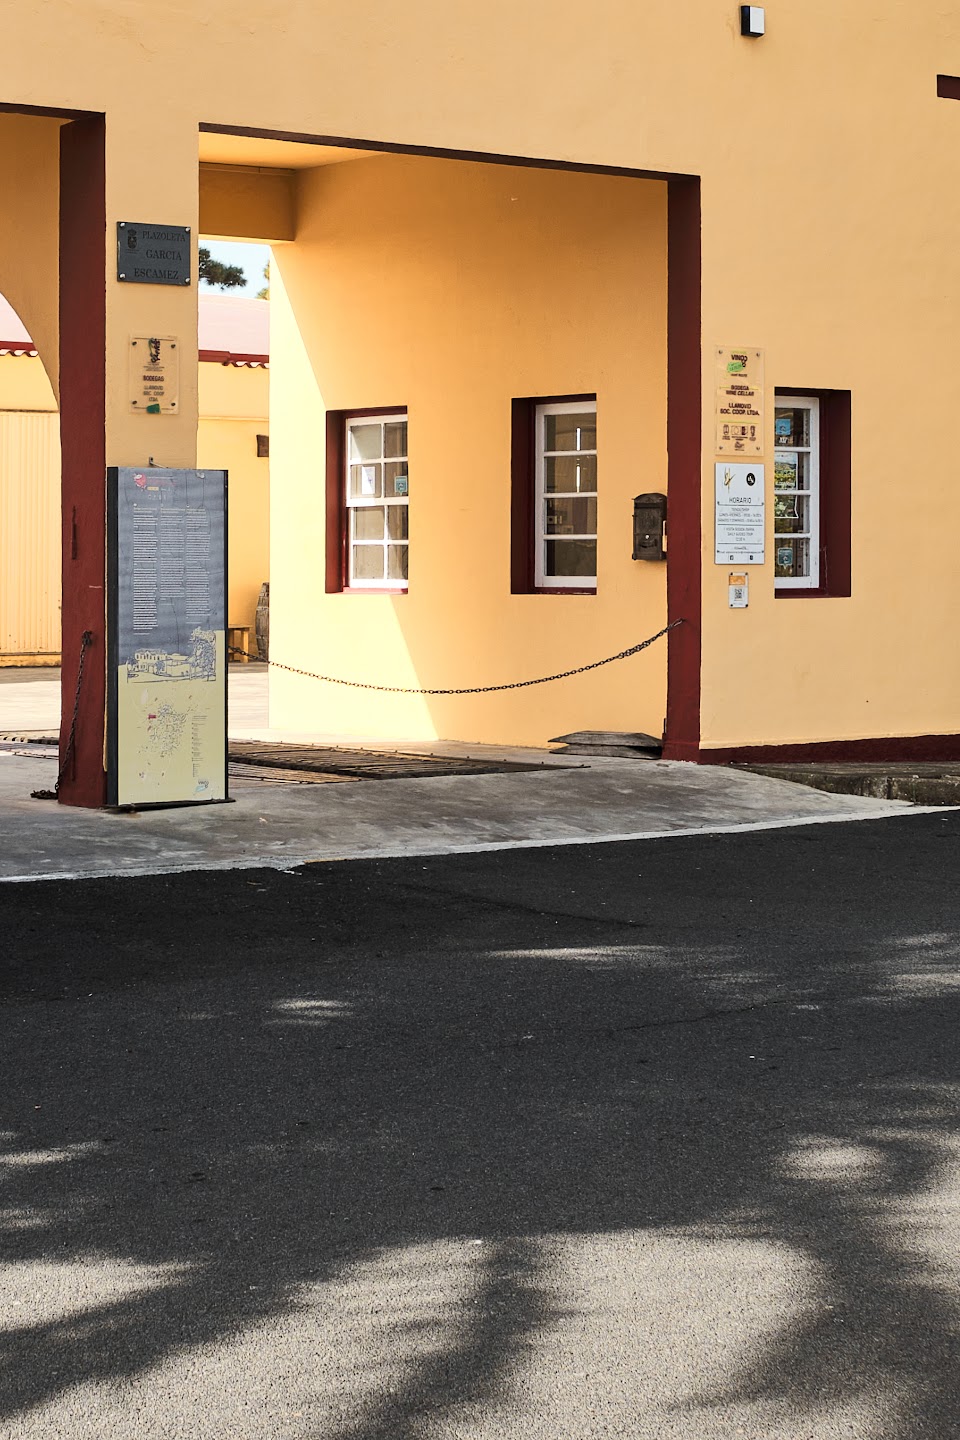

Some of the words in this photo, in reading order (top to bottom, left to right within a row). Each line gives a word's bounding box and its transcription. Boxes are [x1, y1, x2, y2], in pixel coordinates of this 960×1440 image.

[142, 231, 186, 242] PLAZOLETA
[146, 249, 182, 261] GARCIA
[134, 268, 179, 280] ESCAMEZ
